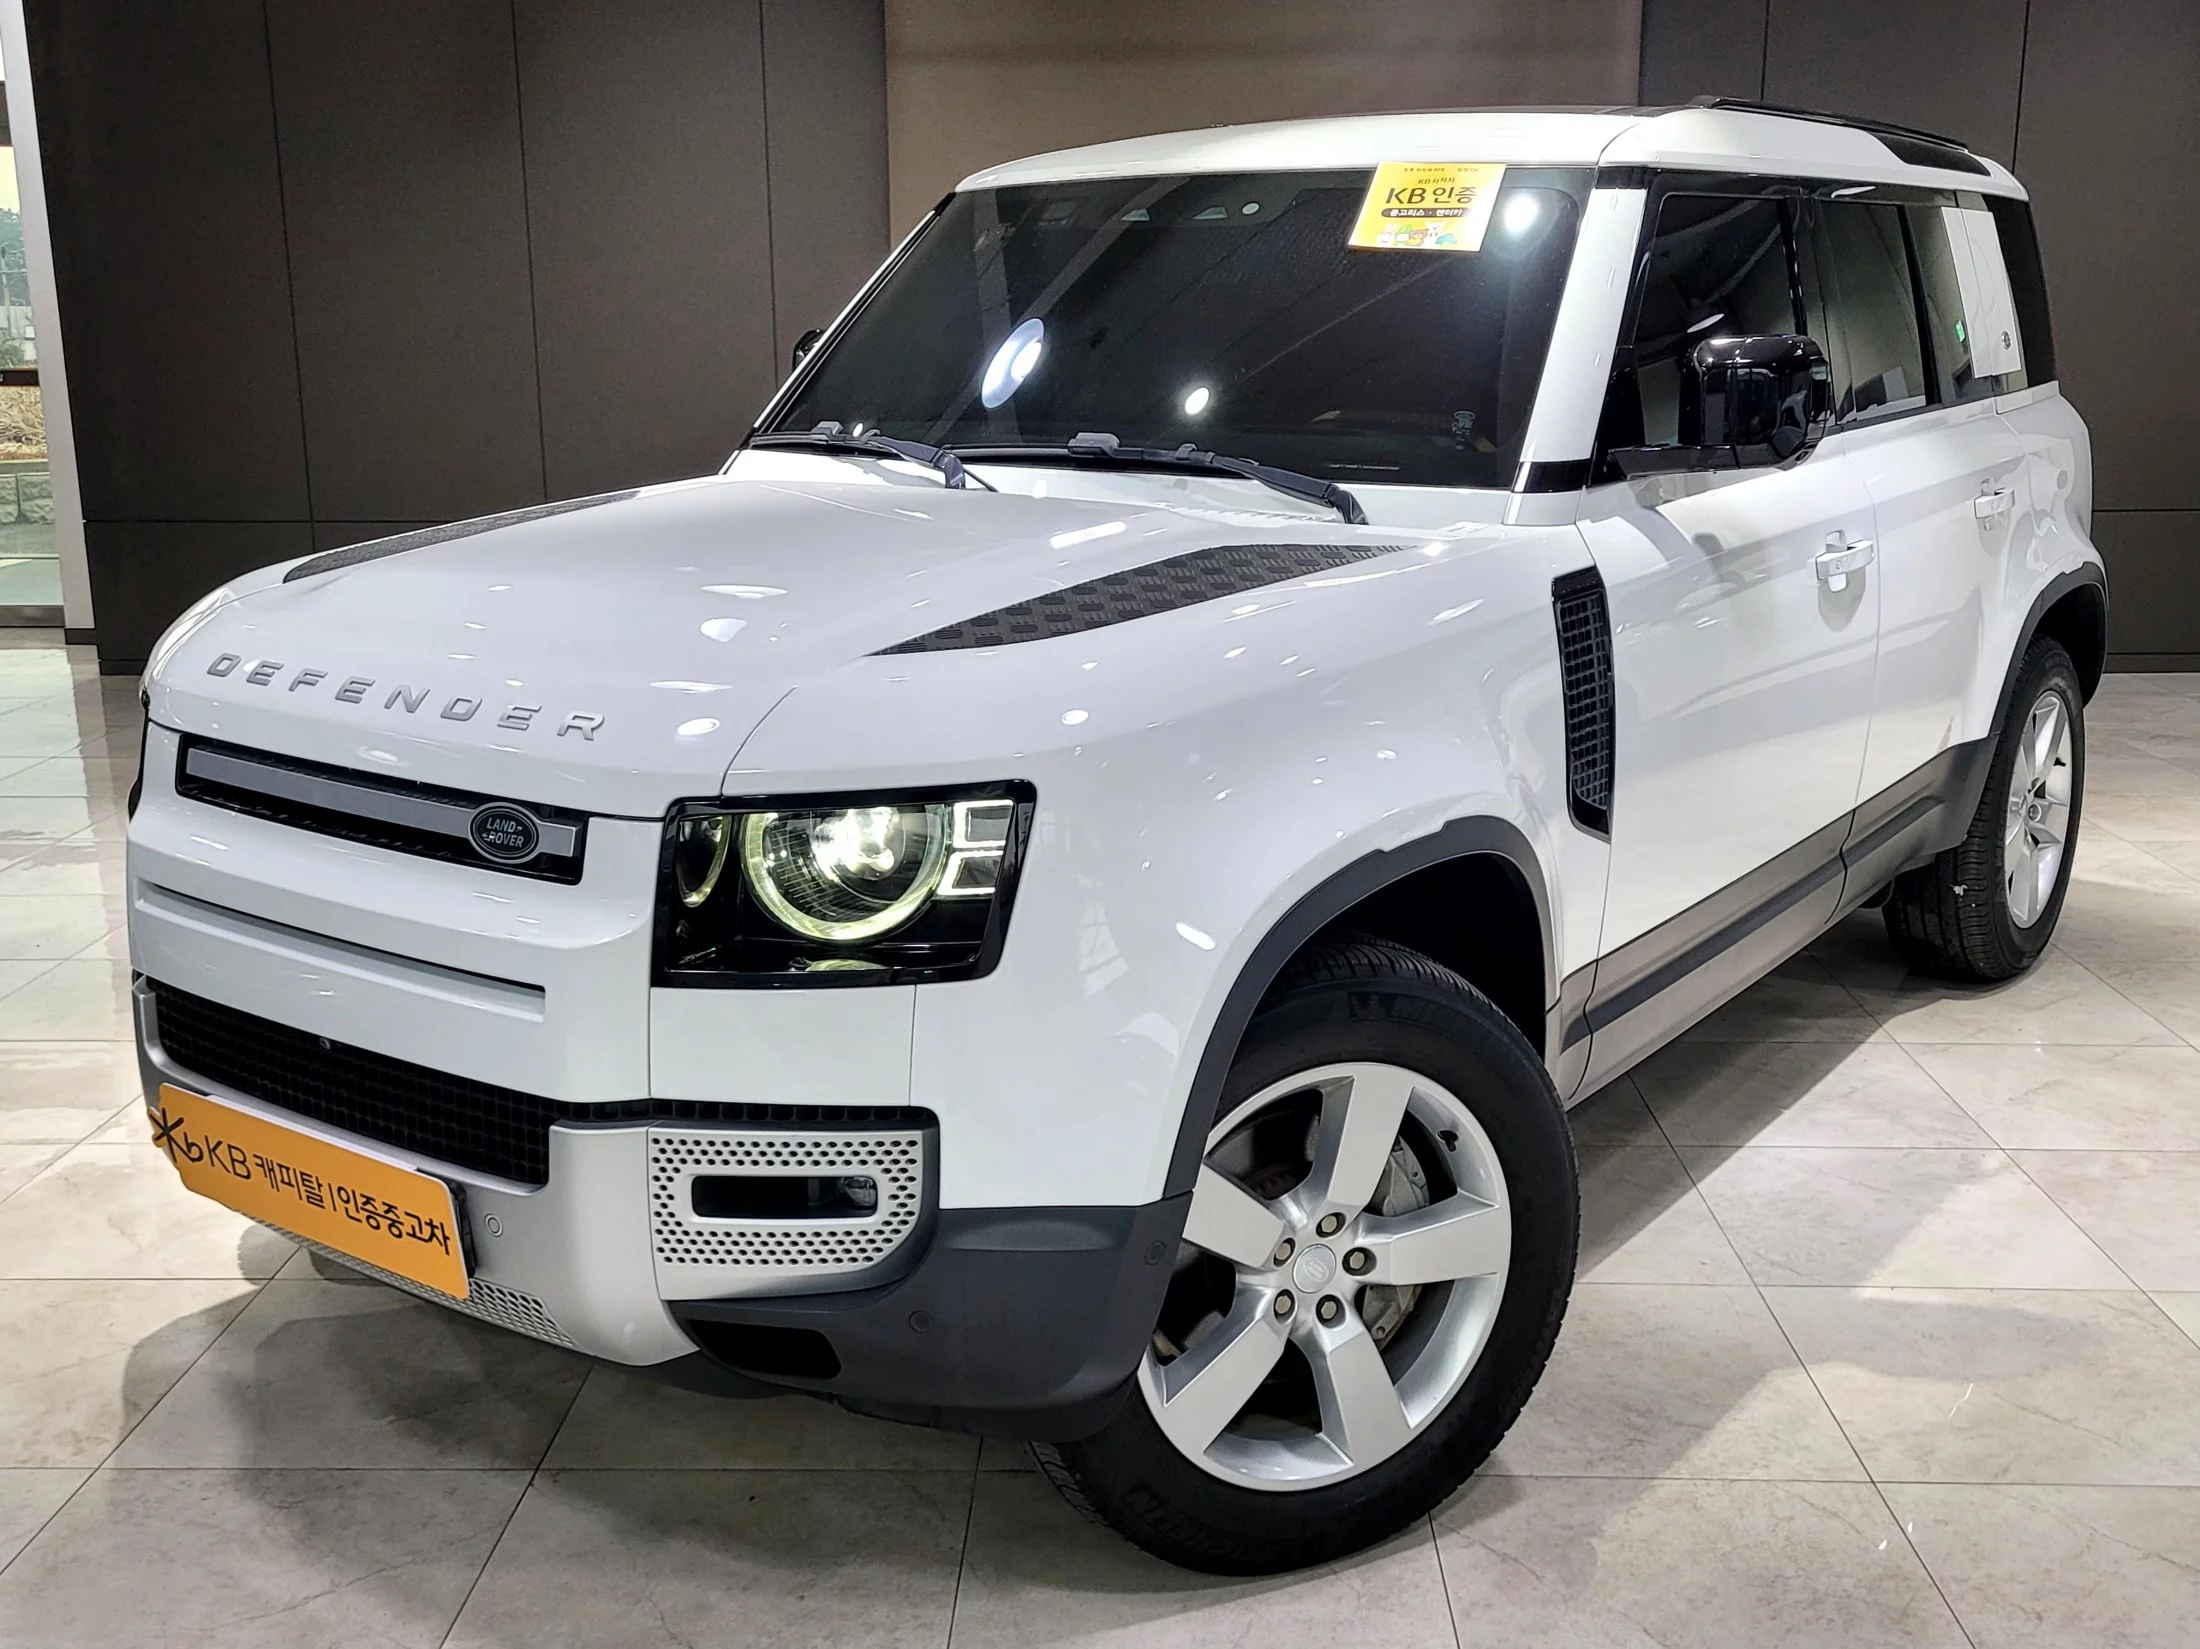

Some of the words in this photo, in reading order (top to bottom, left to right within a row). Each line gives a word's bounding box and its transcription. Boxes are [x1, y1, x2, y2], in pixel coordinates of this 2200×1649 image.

[1386, 187, 1426, 204] KB
[1432, 186, 1477, 204] 인증
[207, 652, 605, 741] DEFENDER
[486, 817, 517, 833] LAND
[488, 831, 524, 848] ROVER
